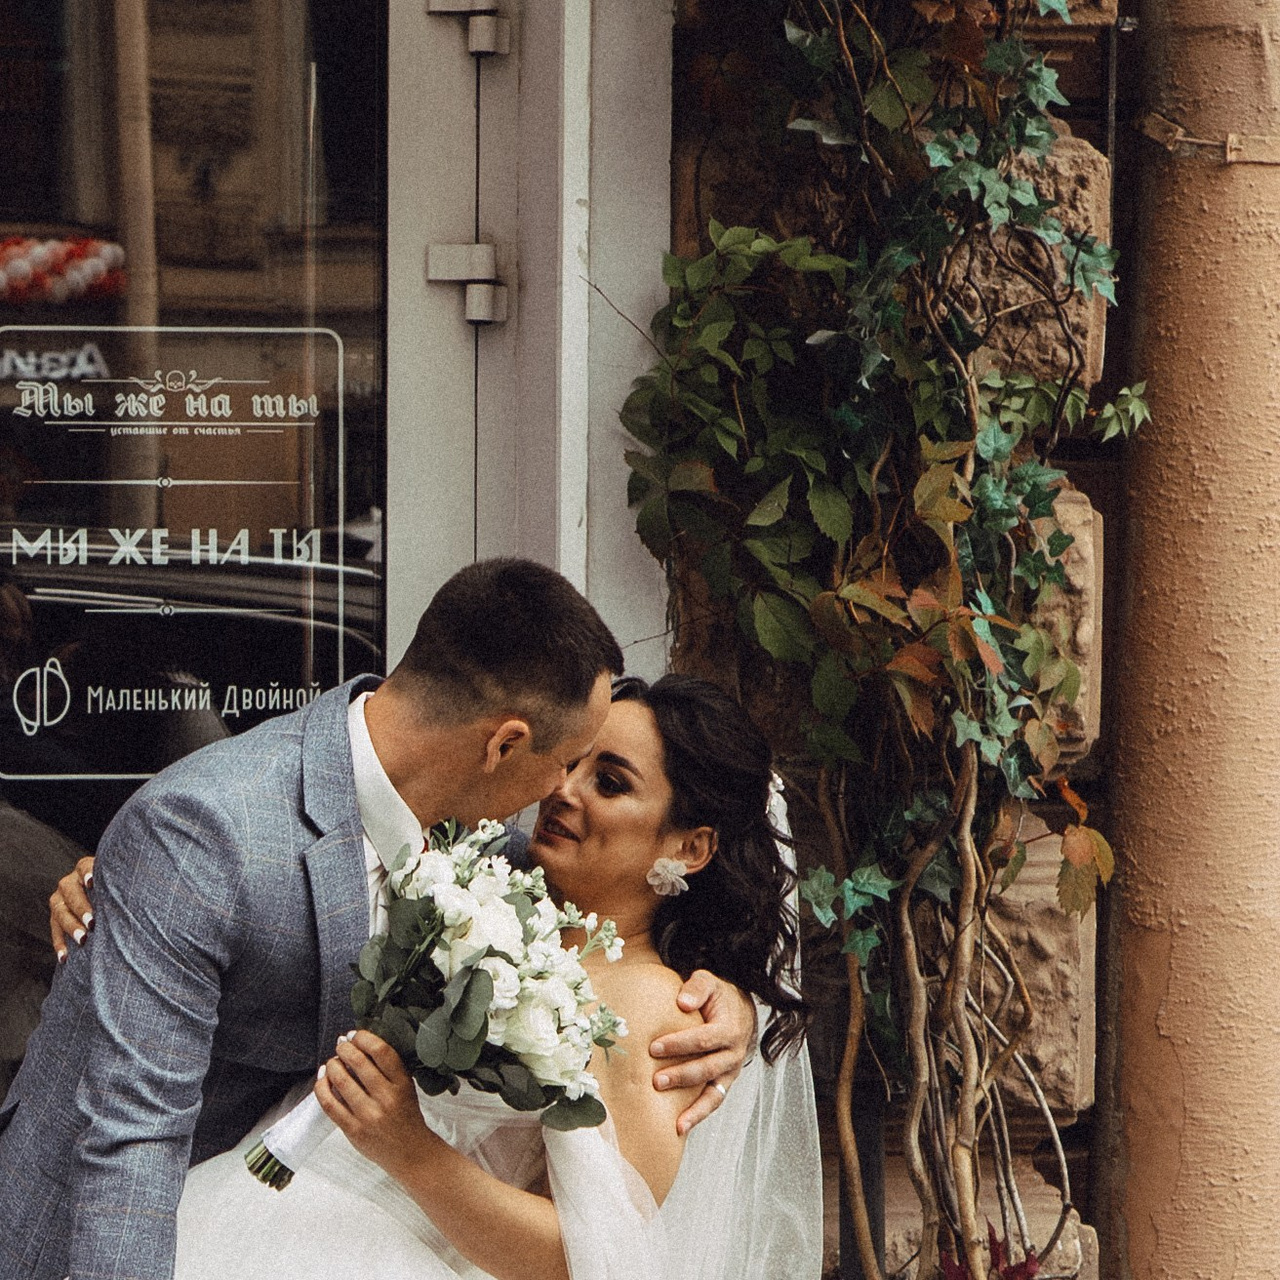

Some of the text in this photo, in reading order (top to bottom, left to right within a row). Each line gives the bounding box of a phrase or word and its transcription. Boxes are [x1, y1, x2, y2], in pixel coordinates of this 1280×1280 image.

[13, 380, 320, 418] Мы же на ты
[171, 425, 190, 436] от
[12, 528, 321, 565] МЫ ЖЕ НА ТЫ
